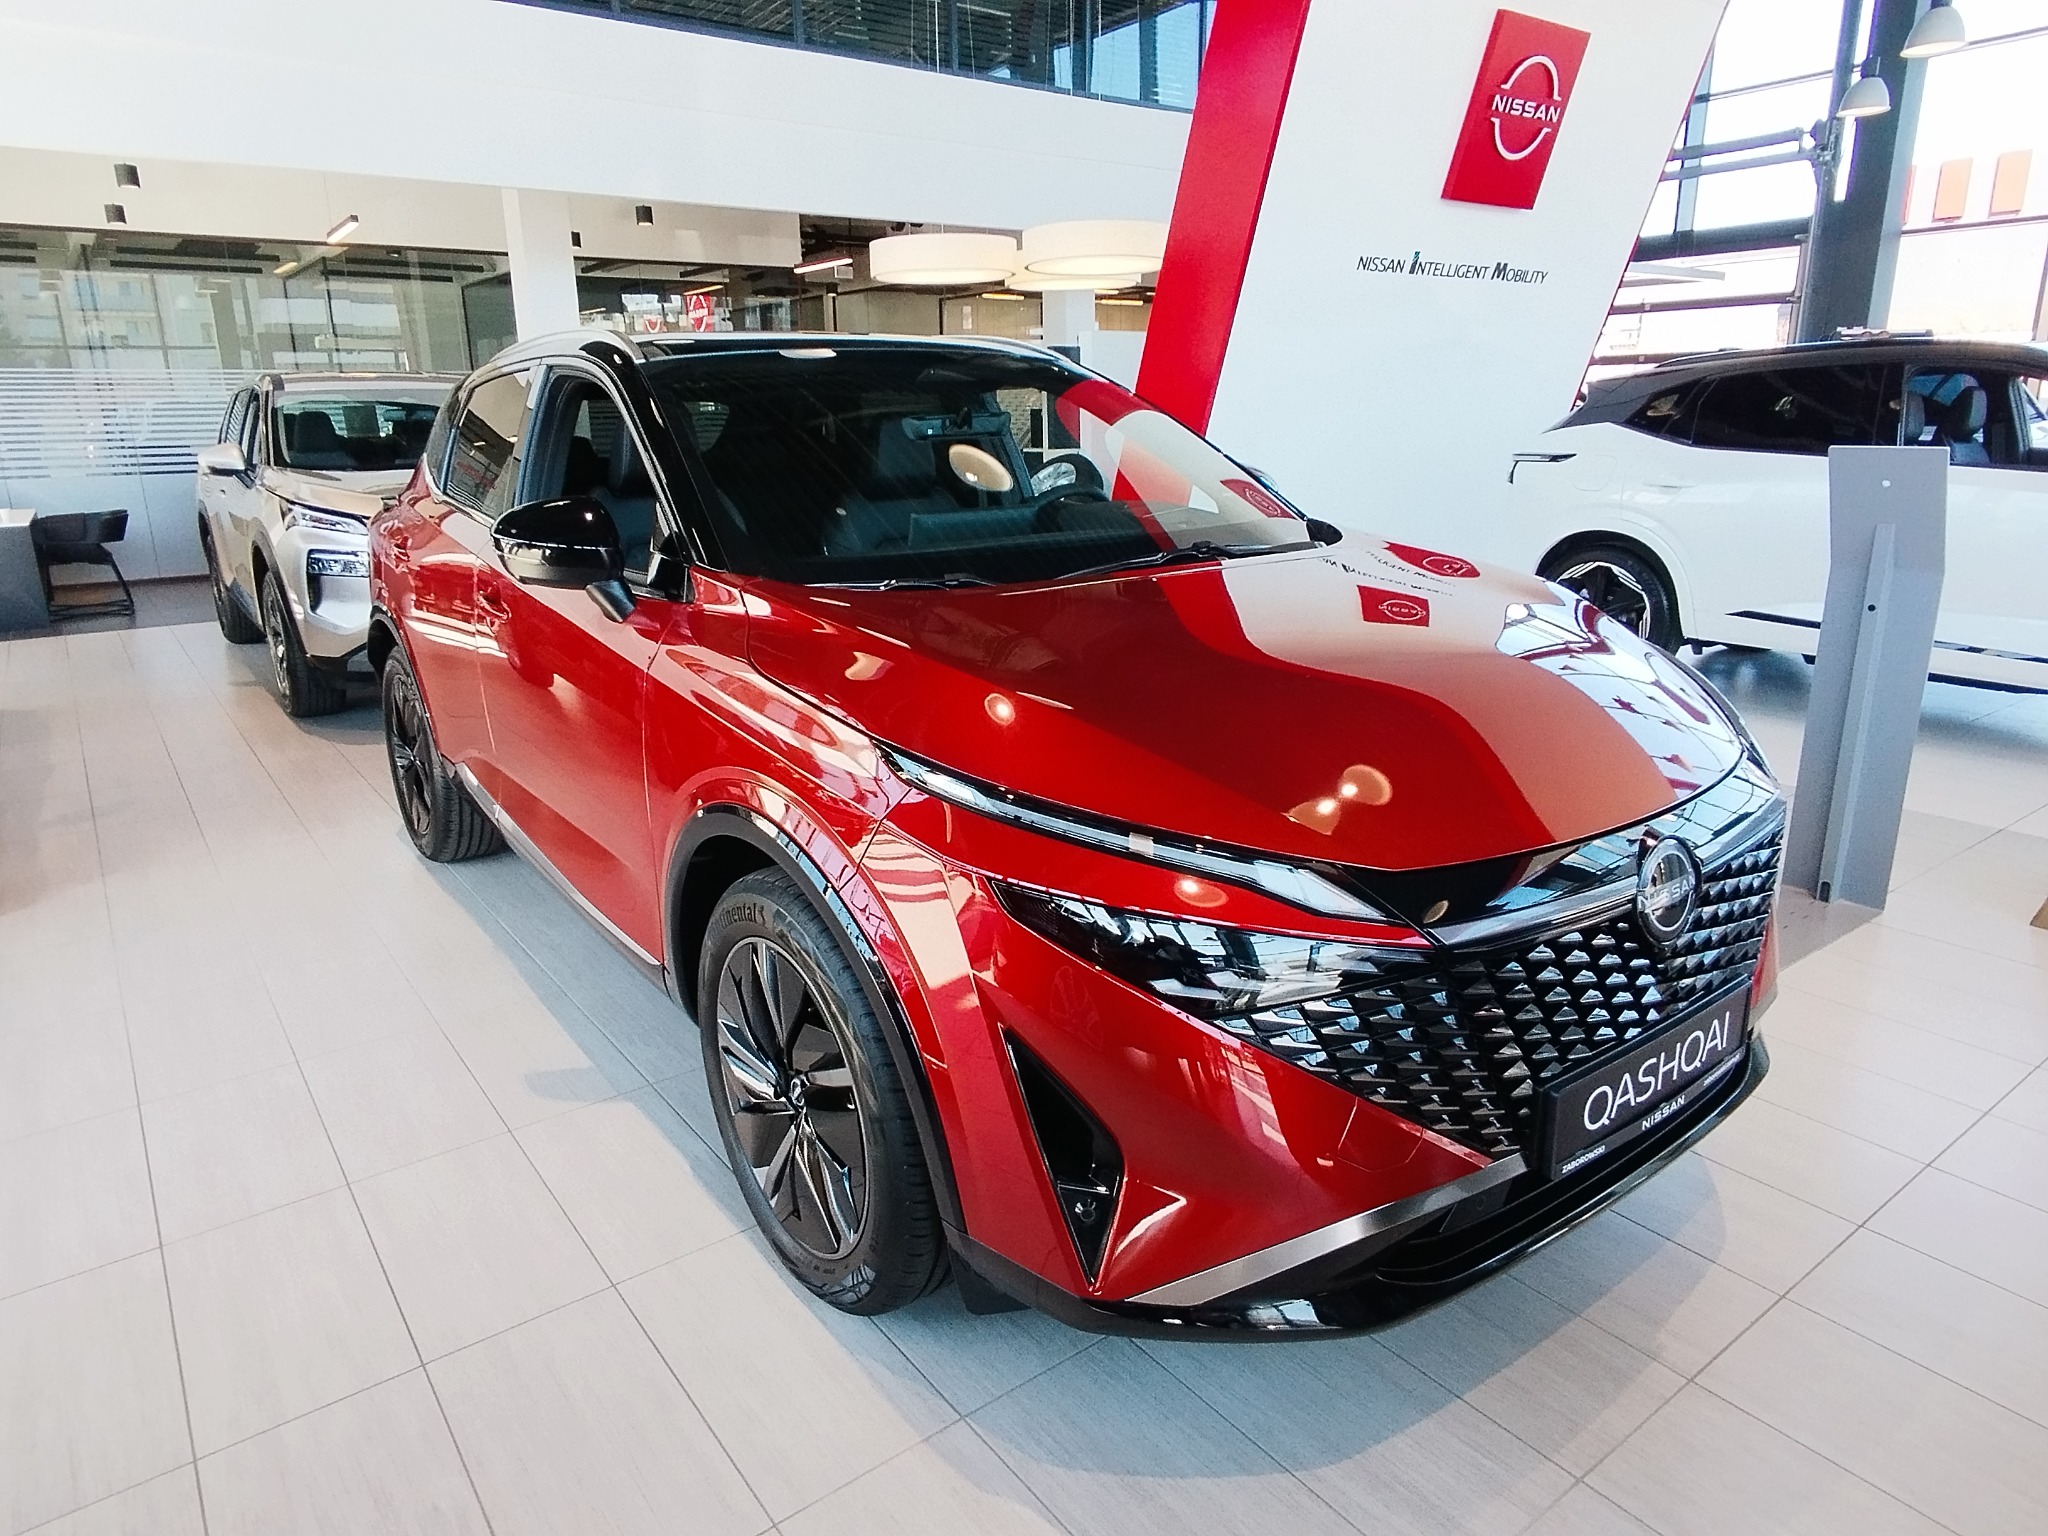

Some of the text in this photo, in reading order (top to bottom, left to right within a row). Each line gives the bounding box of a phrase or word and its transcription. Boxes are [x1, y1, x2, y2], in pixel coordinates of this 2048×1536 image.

[1492, 94, 1561, 123] NISSAN
[1356, 251, 1549, 284] NISSAN INTELLIGENT MOBILITY
[1637, 873, 1696, 912] NISSAN
[1583, 1011, 1730, 1131] QASHQAI
[1641, 1095, 1686, 1131] NISSAN
